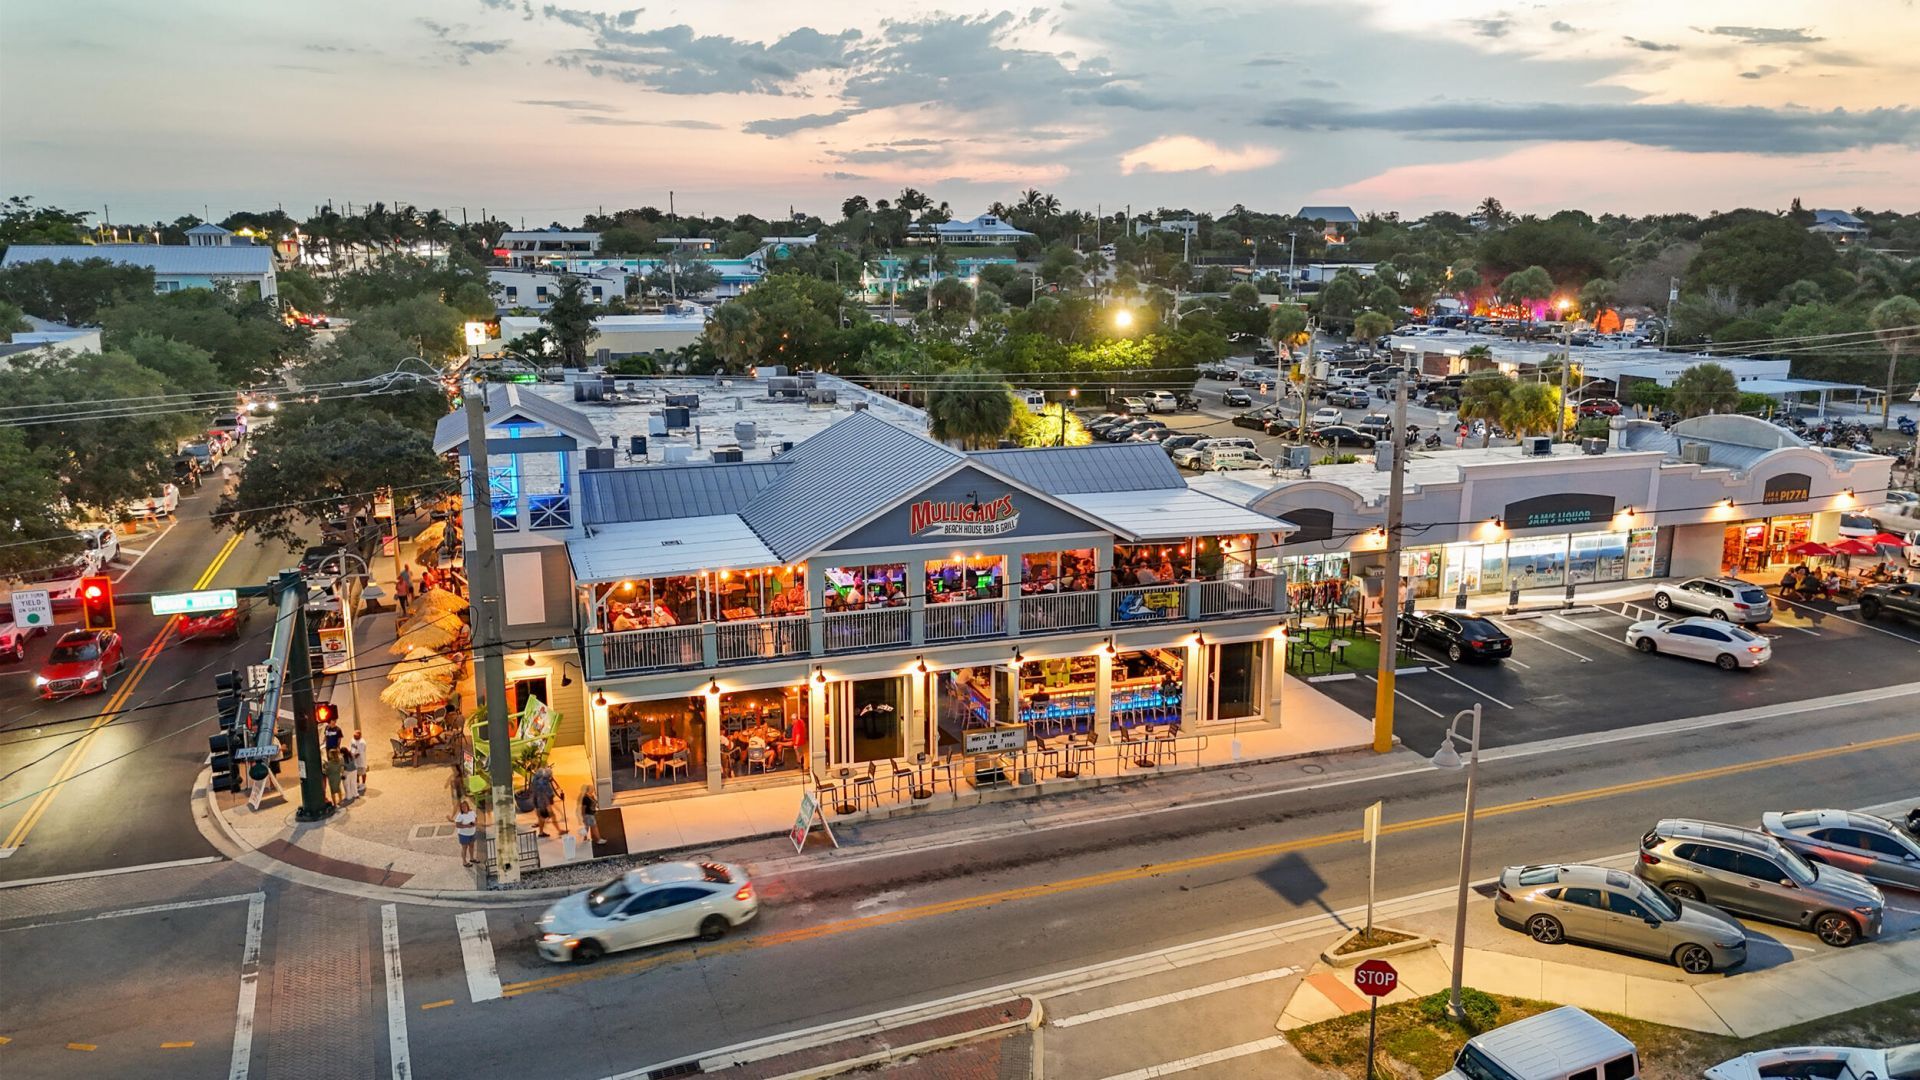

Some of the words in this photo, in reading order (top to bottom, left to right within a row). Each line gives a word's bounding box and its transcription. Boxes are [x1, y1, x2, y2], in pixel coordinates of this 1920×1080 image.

[1780, 489, 1808, 501] PIZZA
[911, 495, 1012, 535] MULLIGAN'S
[944, 524, 962, 534] BEACH
[963, 524, 982, 534] HOUSE
[983, 524, 995, 534] BAR
[1000, 519, 1016, 532] GRILL
[1357, 970, 1395, 986] STOP
